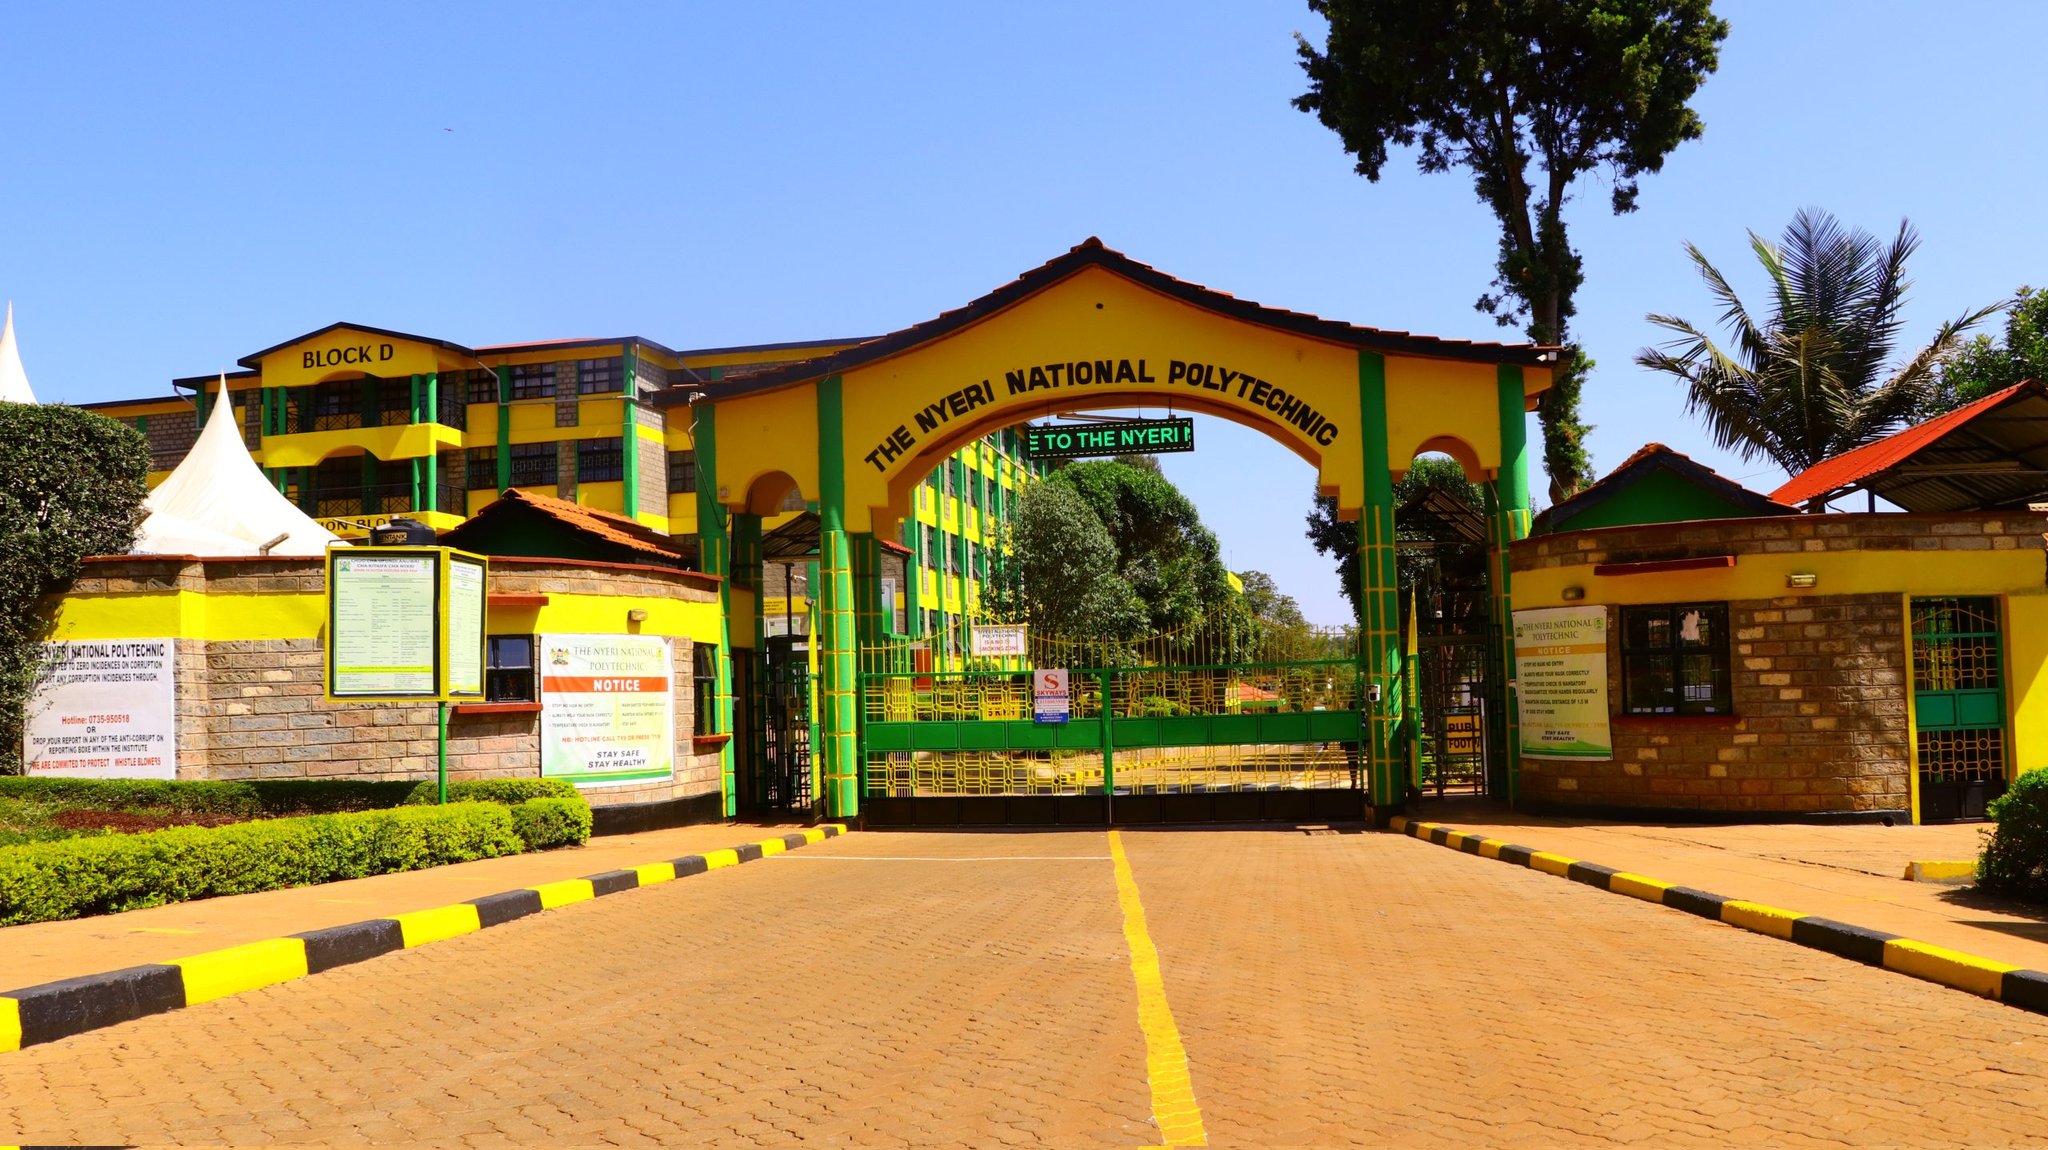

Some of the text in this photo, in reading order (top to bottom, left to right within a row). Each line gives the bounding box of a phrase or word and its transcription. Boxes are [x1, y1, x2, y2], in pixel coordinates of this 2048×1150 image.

[304, 343, 394, 369] BLOCK D
[864, 359, 1339, 473] THE NYERI NATIONAL POLYTECHNIC
[1044, 434, 1071, 450] TO
[1077, 431, 1115, 448] THE
[1121, 427, 1178, 446] NYERI
[1534, 622, 1552, 630] NYERI
[1554, 619, 1592, 629] NATIONAL
[1532, 631, 1578, 641] POLYTECHNIC
[45, 644, 69, 659] NYERI
[71, 644, 110, 658] NATIONAL
[111, 643, 165, 657] POLYTECHNIC
[574, 647, 654, 656] THE NYERI NATIONAL
[1538, 646, 1571, 654] NOTICE
[68, 662, 75, 671] TO
[76, 661, 89, 670] ZERO
[91, 661, 121, 670] INCIDENCES
[122, 661, 129, 669] ON
[130, 661, 163, 669] CORRUPTION
[590, 662, 645, 671] POLYTECHNIC
[56, 674, 67, 683] ANY
[68, 674, 100, 683] CORRUPTION
[102, 673, 131, 682] INCIDENCES
[1044, 674, 1059, 689] S
[593, 680, 640, 691] NOTICE
[62, 714, 130, 724] Hotline: 0735-950518
[33, 737, 46, 745] DROP
[47, 737, 61, 745] YOUR
[78, 746, 91, 754] BOXE
[122, 744, 148, 752] INSTITUTE
[32, 761, 40, 769] WE
[41, 761, 51, 769] ARE
[79, 760, 86, 768] TO
[87, 759, 109, 767] PROTECT
[115, 758, 137, 766] WHISTLE
[138, 757, 161, 766] BLOWERS
[613, 759, 646, 767] HEALTHY
